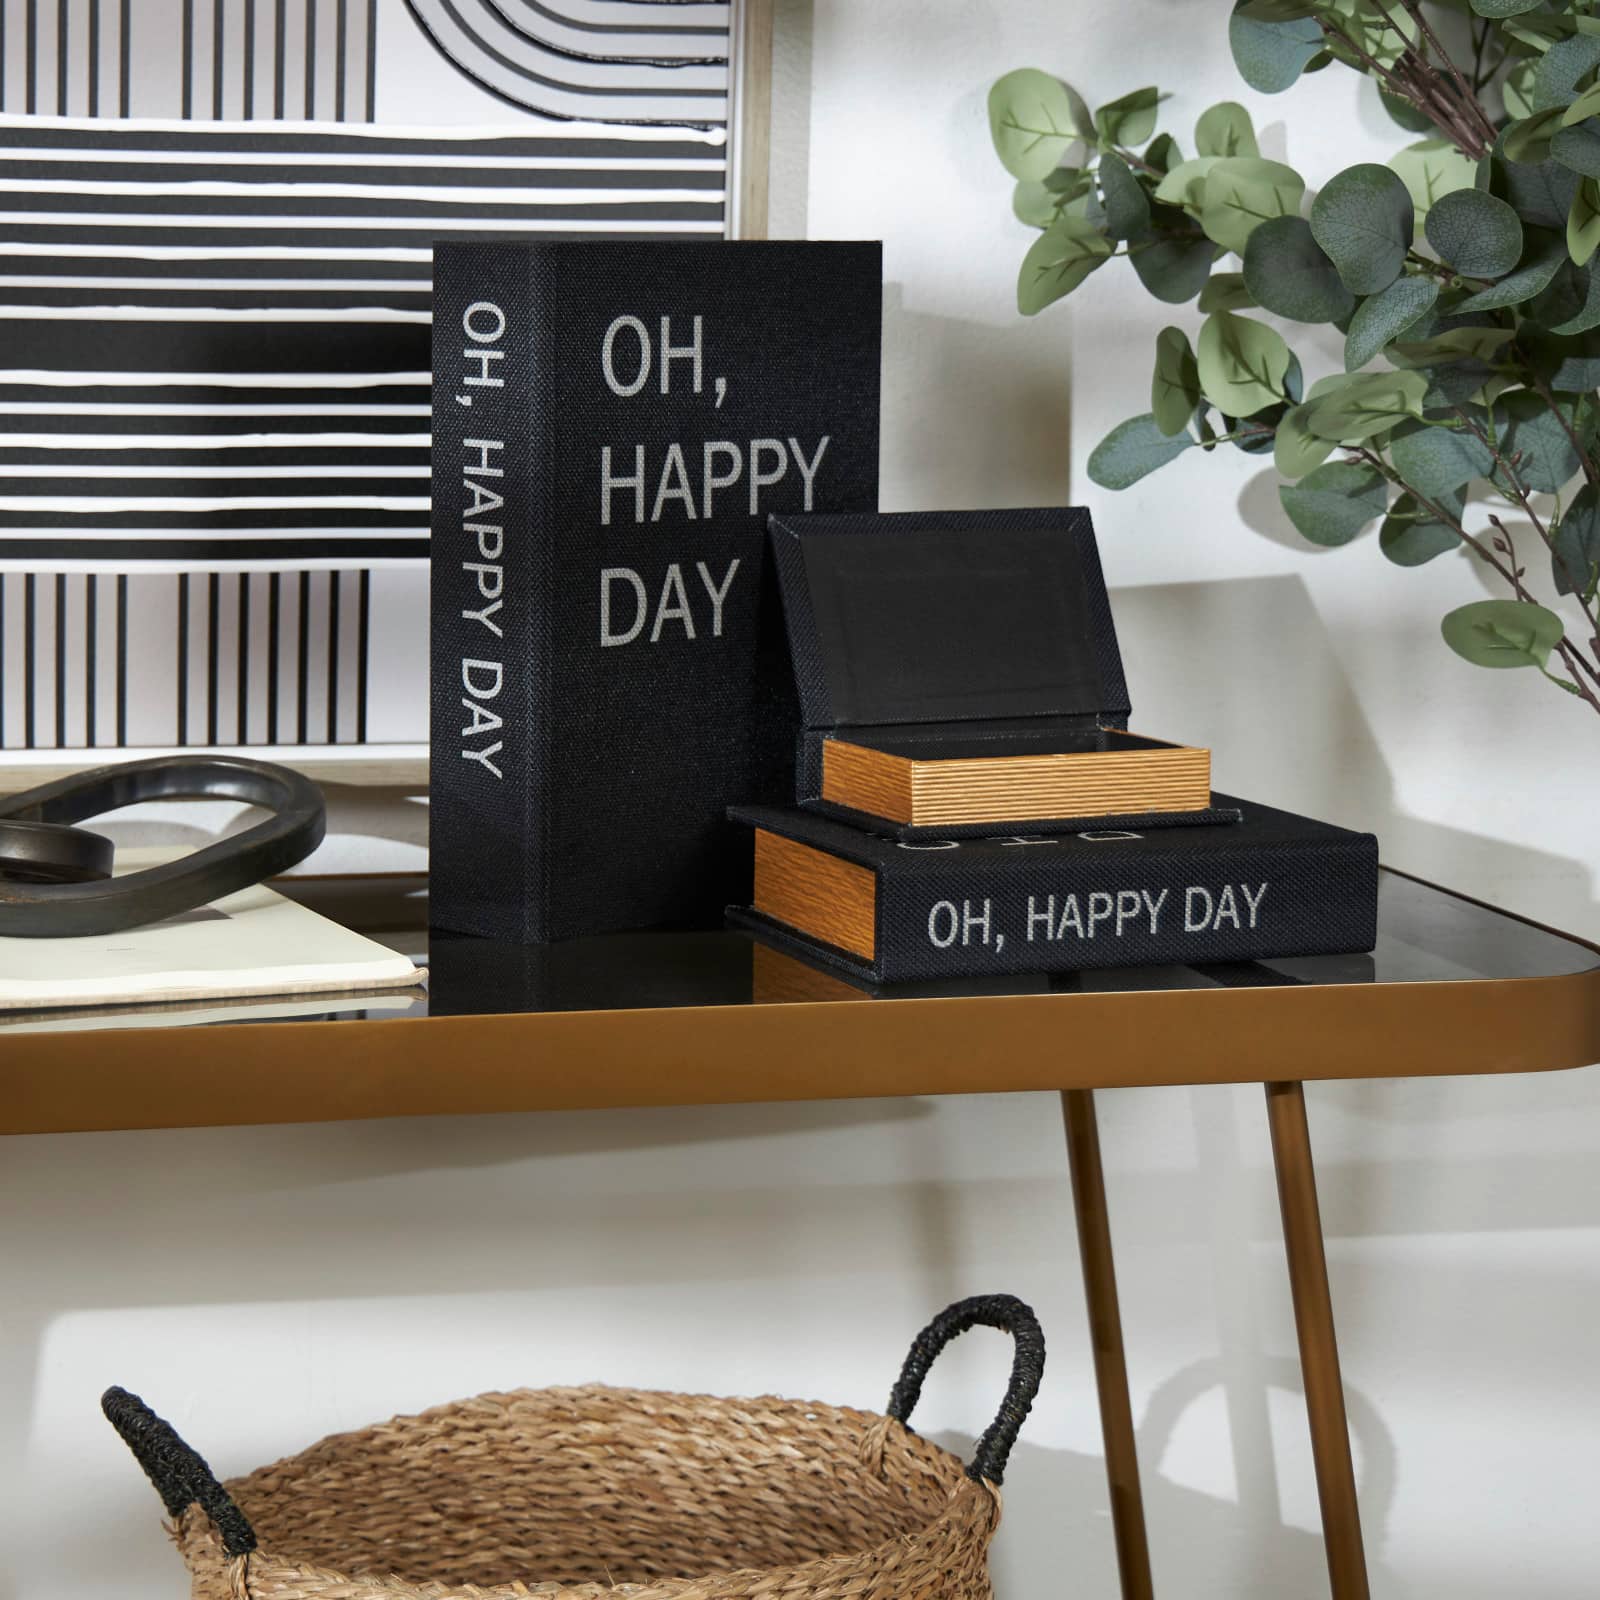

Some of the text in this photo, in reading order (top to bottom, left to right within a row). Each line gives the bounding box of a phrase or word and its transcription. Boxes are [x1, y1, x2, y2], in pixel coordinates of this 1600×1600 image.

[601, 315, 727, 408] OH,
[601, 436, 830, 525] HAPPY
[455, 301, 506, 779] OH, HAPPY DAY
[600, 559, 740, 647] DAY
[927, 883, 1267, 953] OH, HAPPY DAY
